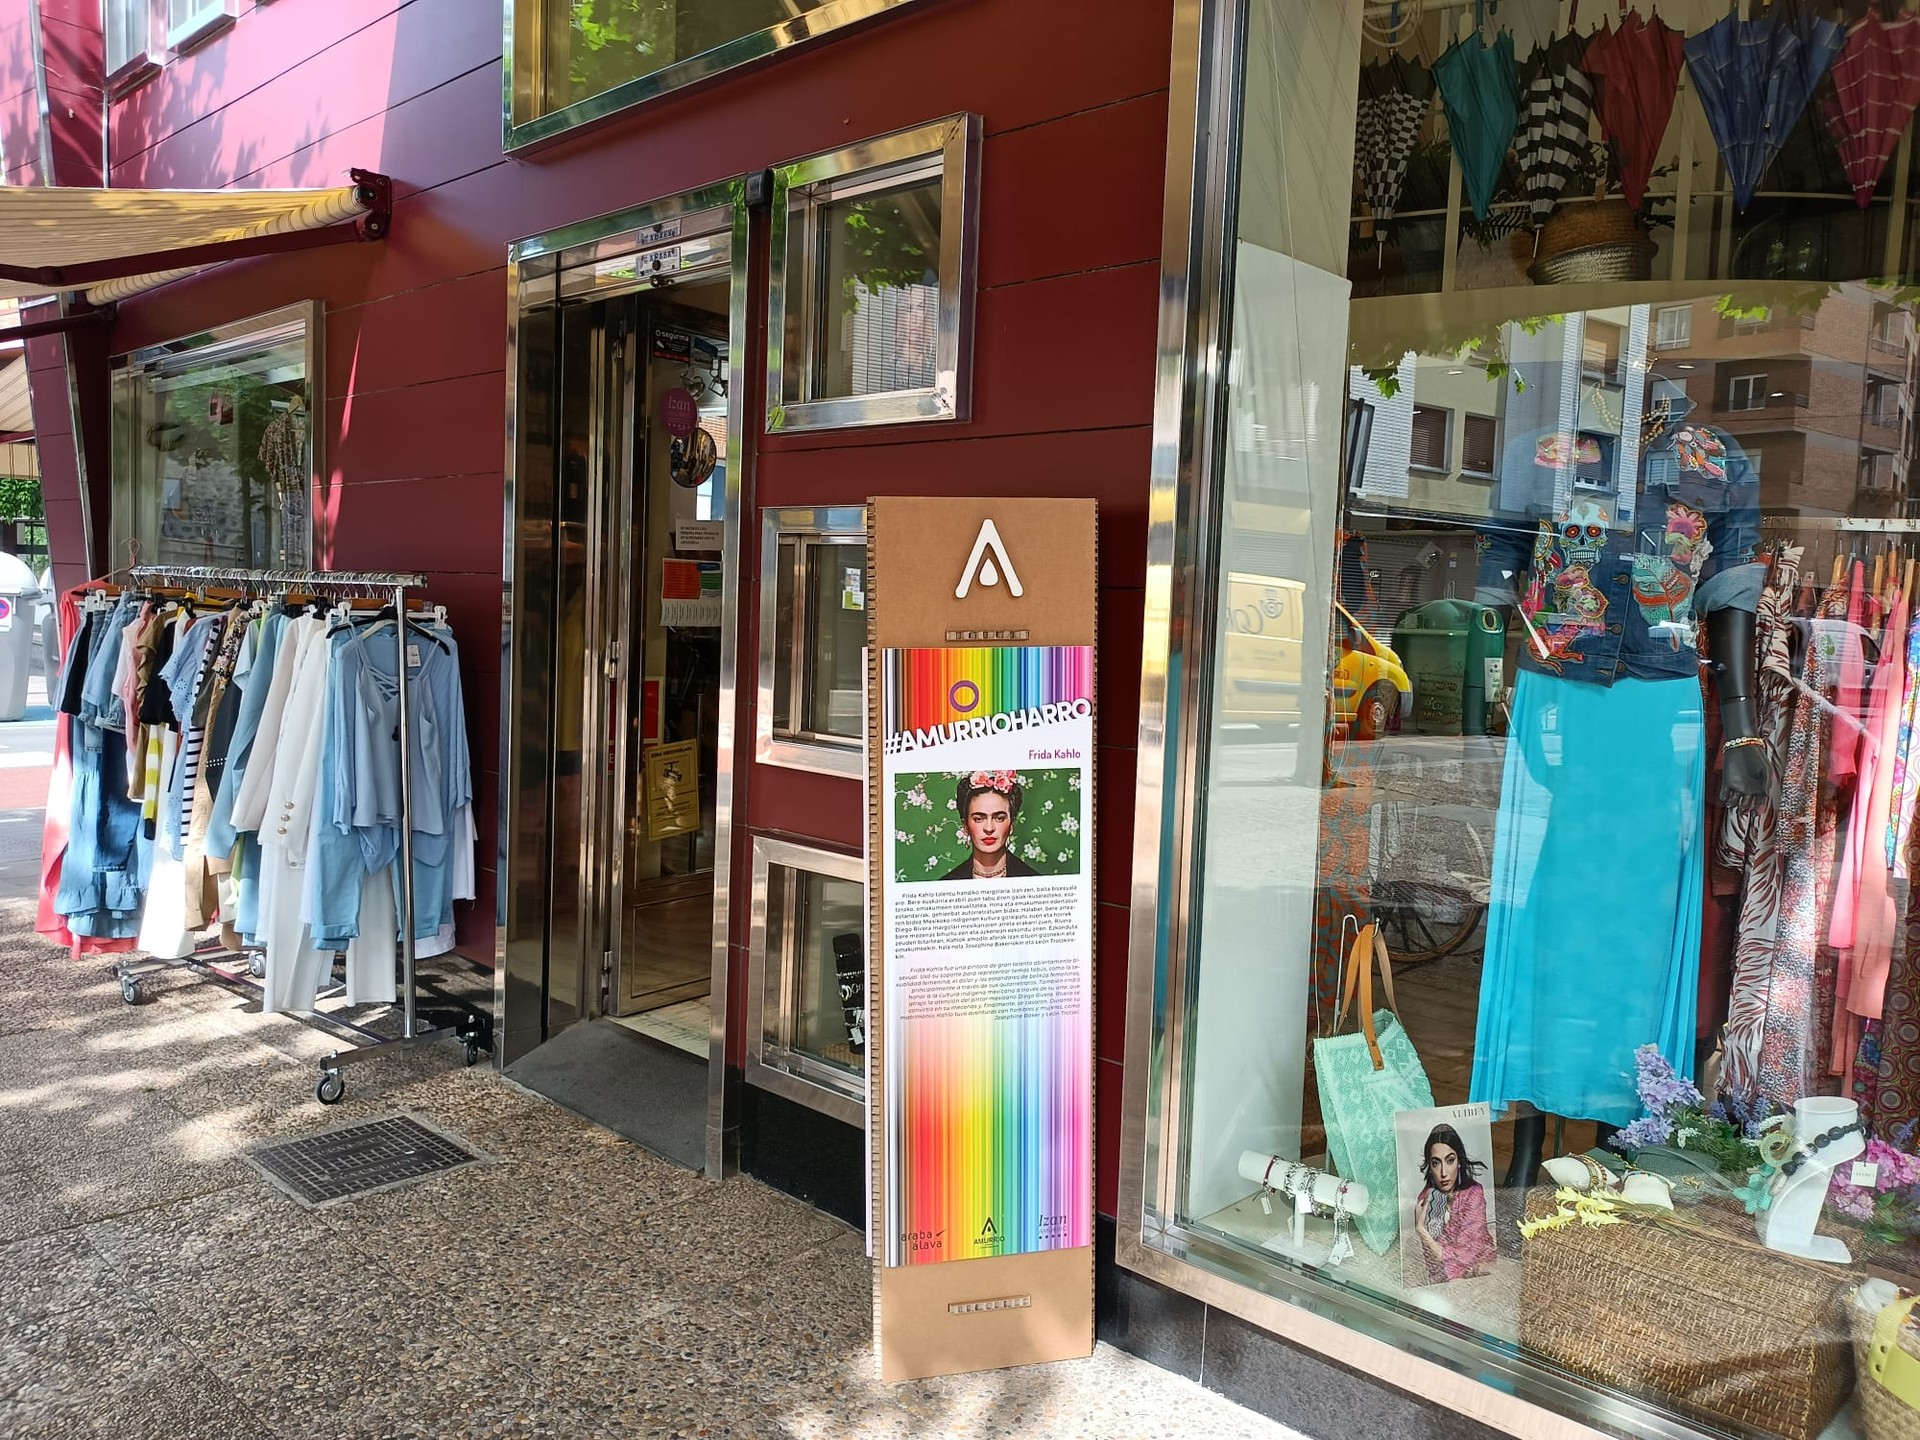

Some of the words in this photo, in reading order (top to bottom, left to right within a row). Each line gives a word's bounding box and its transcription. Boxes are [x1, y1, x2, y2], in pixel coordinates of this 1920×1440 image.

[885, 697, 1092, 755] #AMURRIOHARRO
[1028, 749, 1052, 760] Frida
[1054, 748, 1081, 760] Kahlo
[1039, 1214, 1067, 1226] Izan
[900, 1230, 932, 1242] araba
[973, 1235, 1005, 1244] AMURRIO
[912, 1240, 942, 1250] álava
